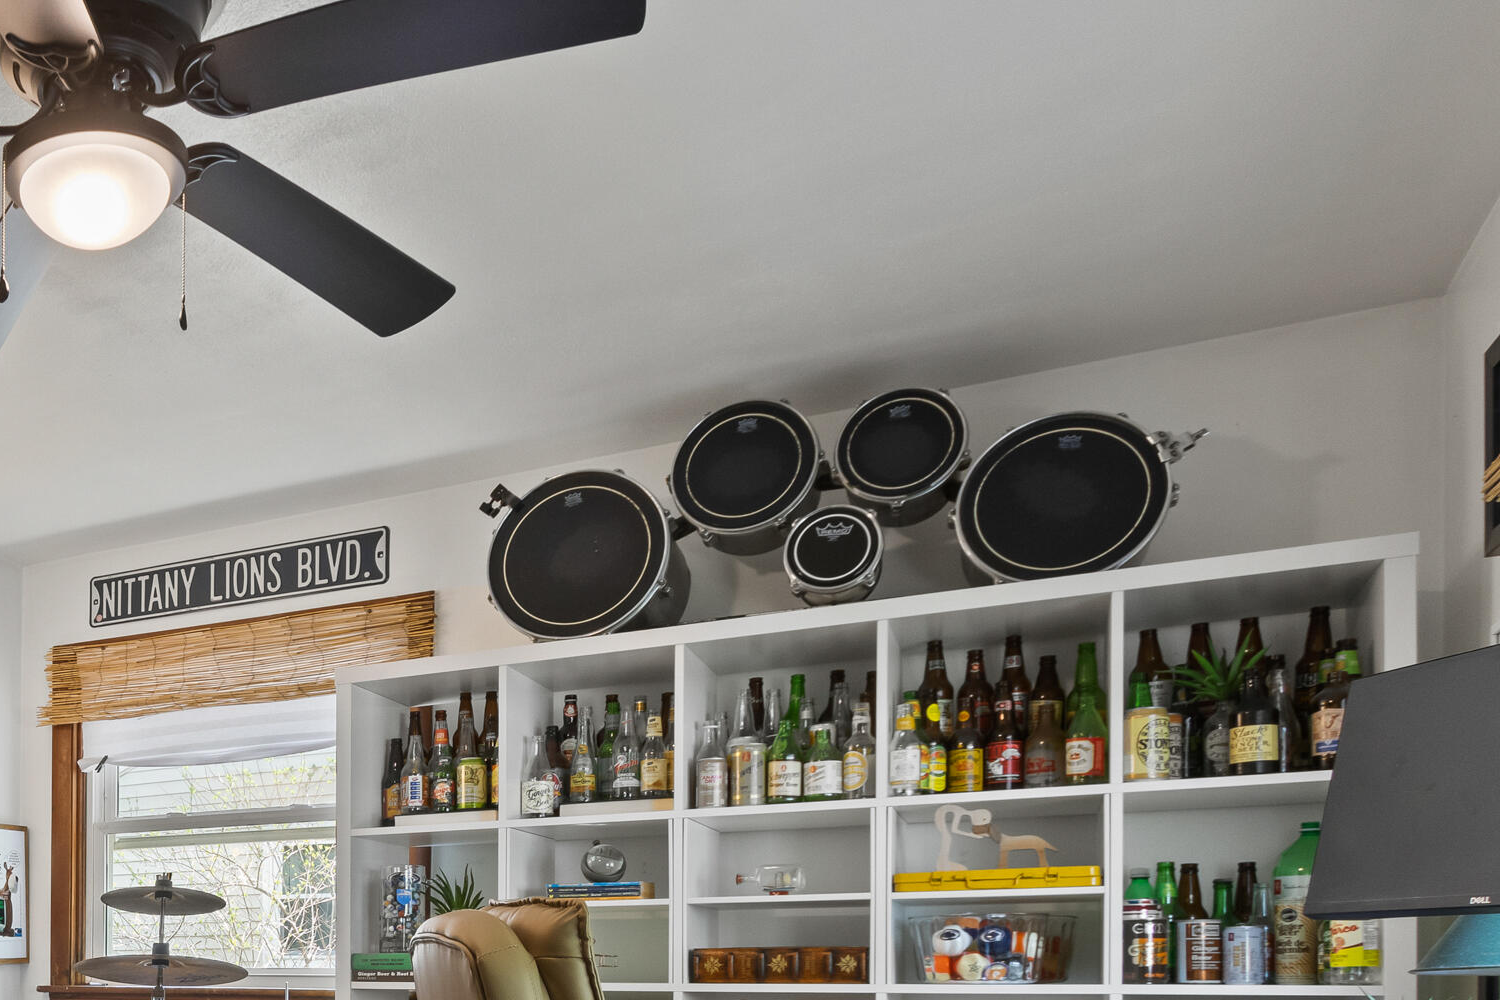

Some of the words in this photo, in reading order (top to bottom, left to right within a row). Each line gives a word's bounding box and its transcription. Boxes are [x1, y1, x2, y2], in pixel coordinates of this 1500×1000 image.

[102, 566, 196, 619] NITTANY
[209, 551, 283, 602] LIONS
[297, 538, 371, 589] BLVD.
[1470, 896, 1491, 904] DELL
